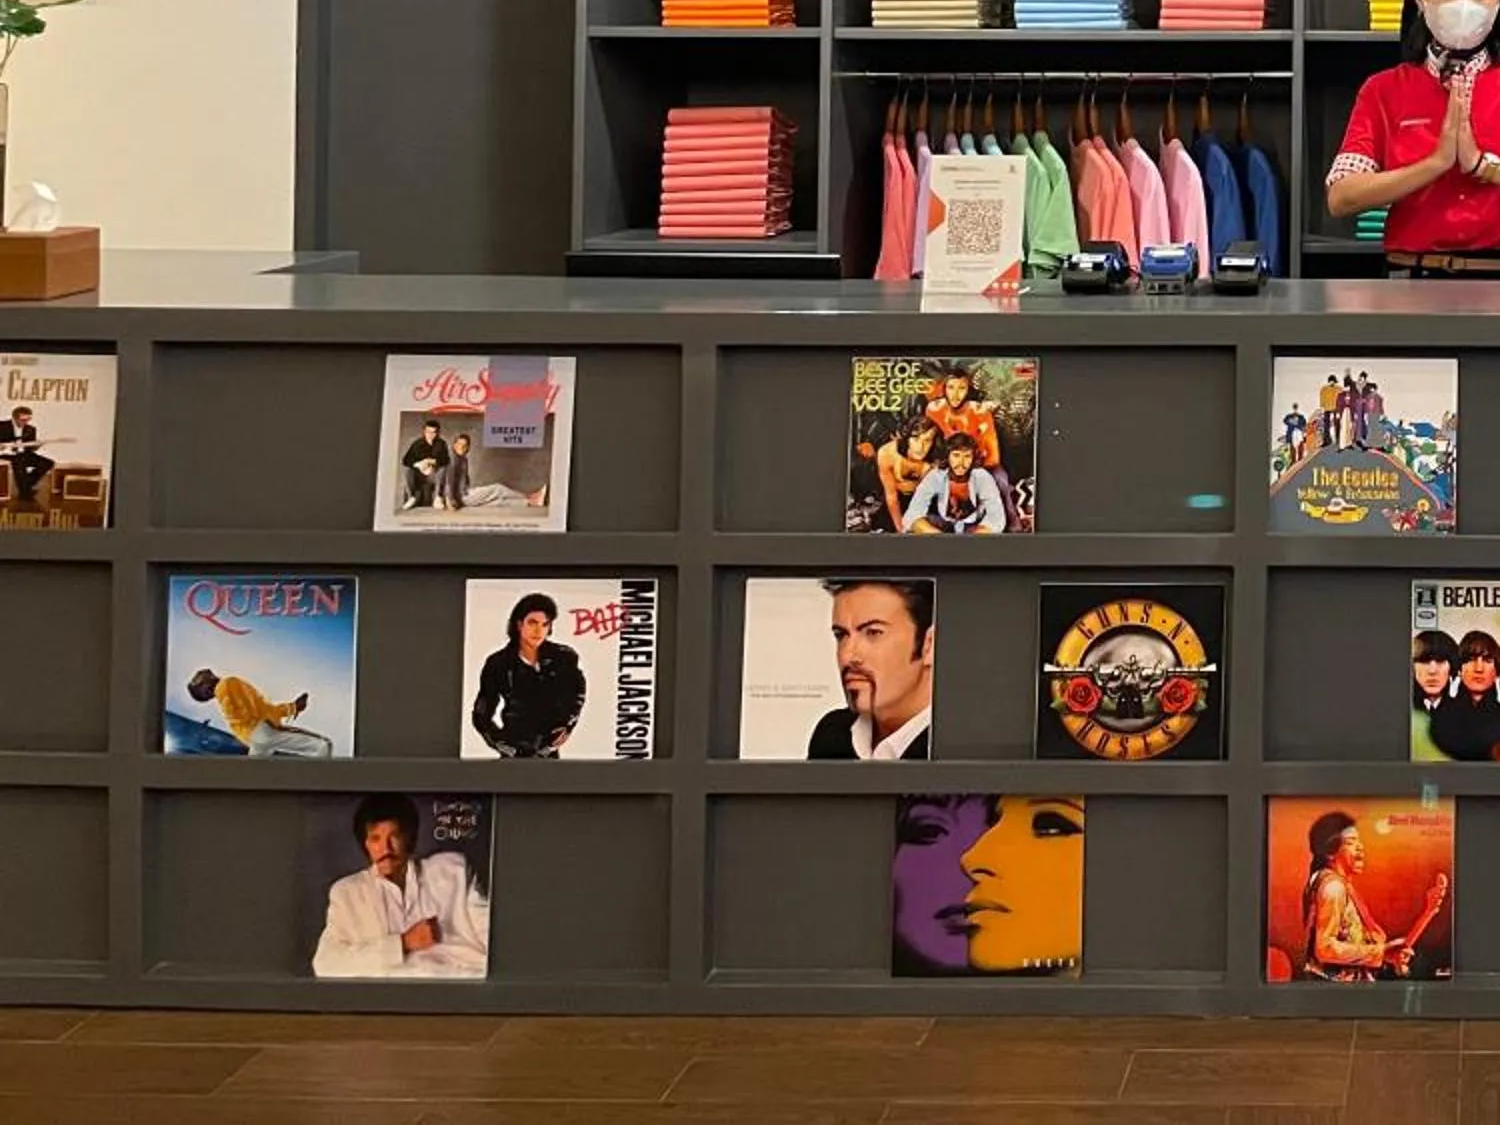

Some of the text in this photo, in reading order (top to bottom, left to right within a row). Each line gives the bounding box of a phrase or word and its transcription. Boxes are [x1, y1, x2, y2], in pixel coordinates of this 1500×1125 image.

[854, 378, 934, 394] BEE GEES
[184, 580, 346, 640] QUEEN
[569, 602, 631, 639] BAD
[619, 580, 655, 673] MICHAEL
